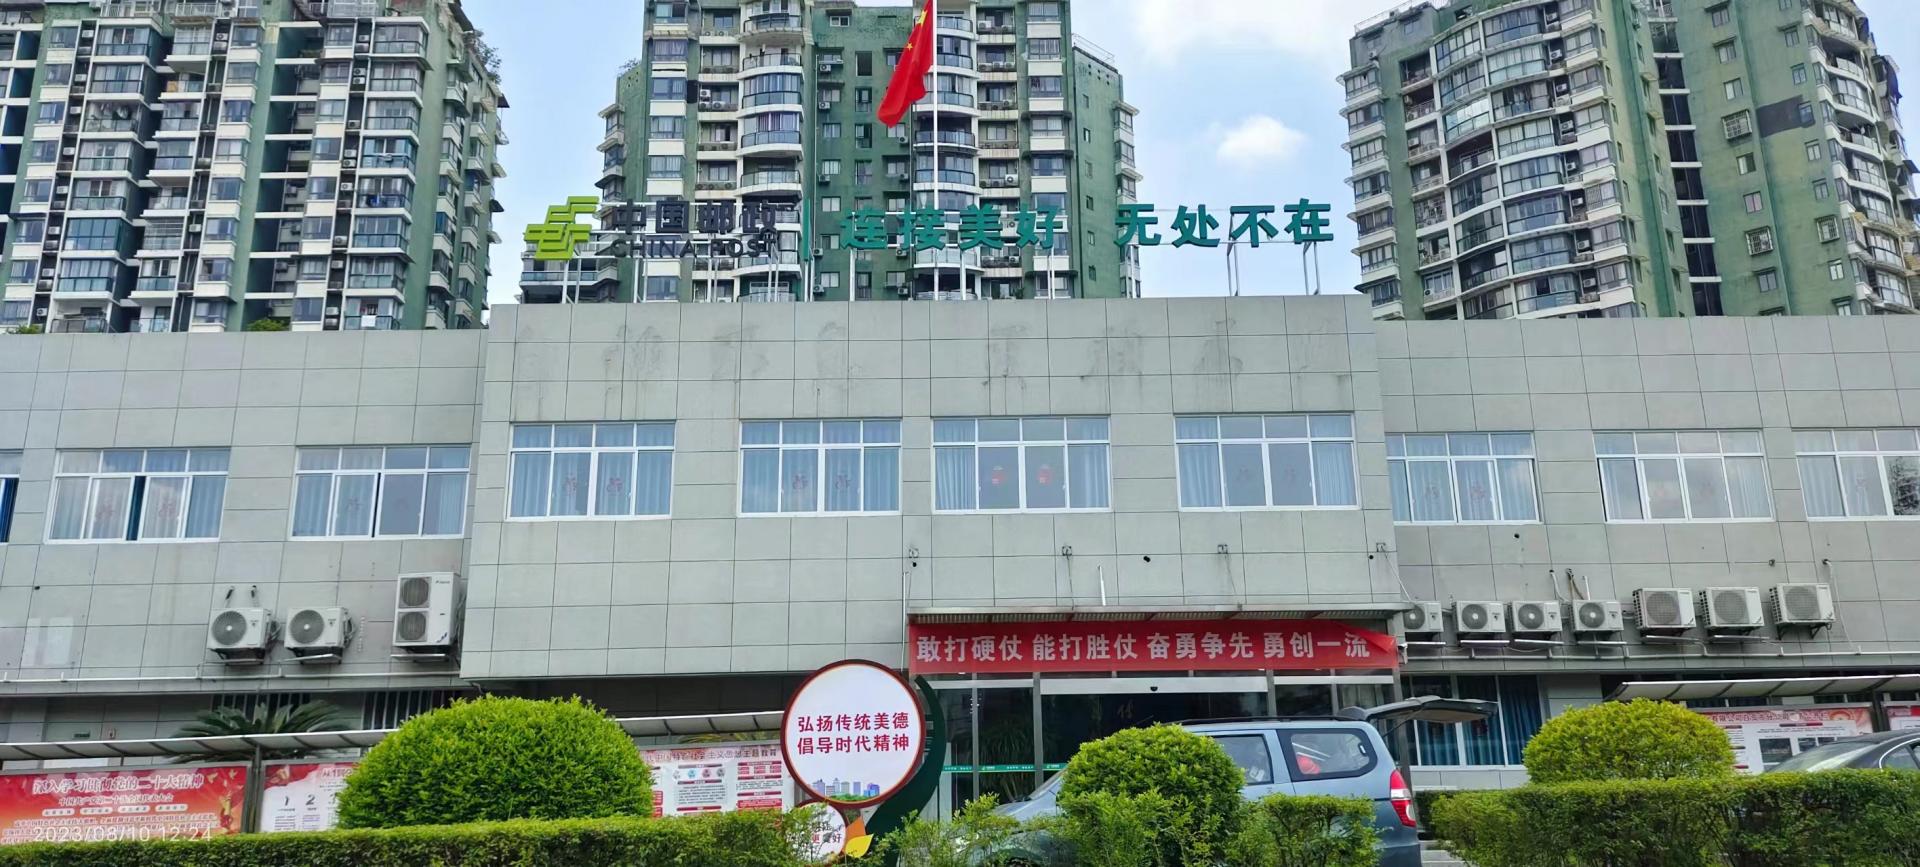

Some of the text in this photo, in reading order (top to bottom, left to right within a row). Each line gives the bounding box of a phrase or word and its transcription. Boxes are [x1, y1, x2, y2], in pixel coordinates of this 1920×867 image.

[611, 200, 778, 235] 中国邮政
[841, 197, 1334, 251] 连接美好 无处不在
[610, 236, 777, 258] CHINA POST
[916, 631, 1371, 663] 敢打硬仗 能打胜仗 奋勇争先 勇创一流
[797, 712, 909, 733] 弘扬传统美德
[797, 734, 909, 755] 倡导时代精神
[306, 794, 315, 805] 2
